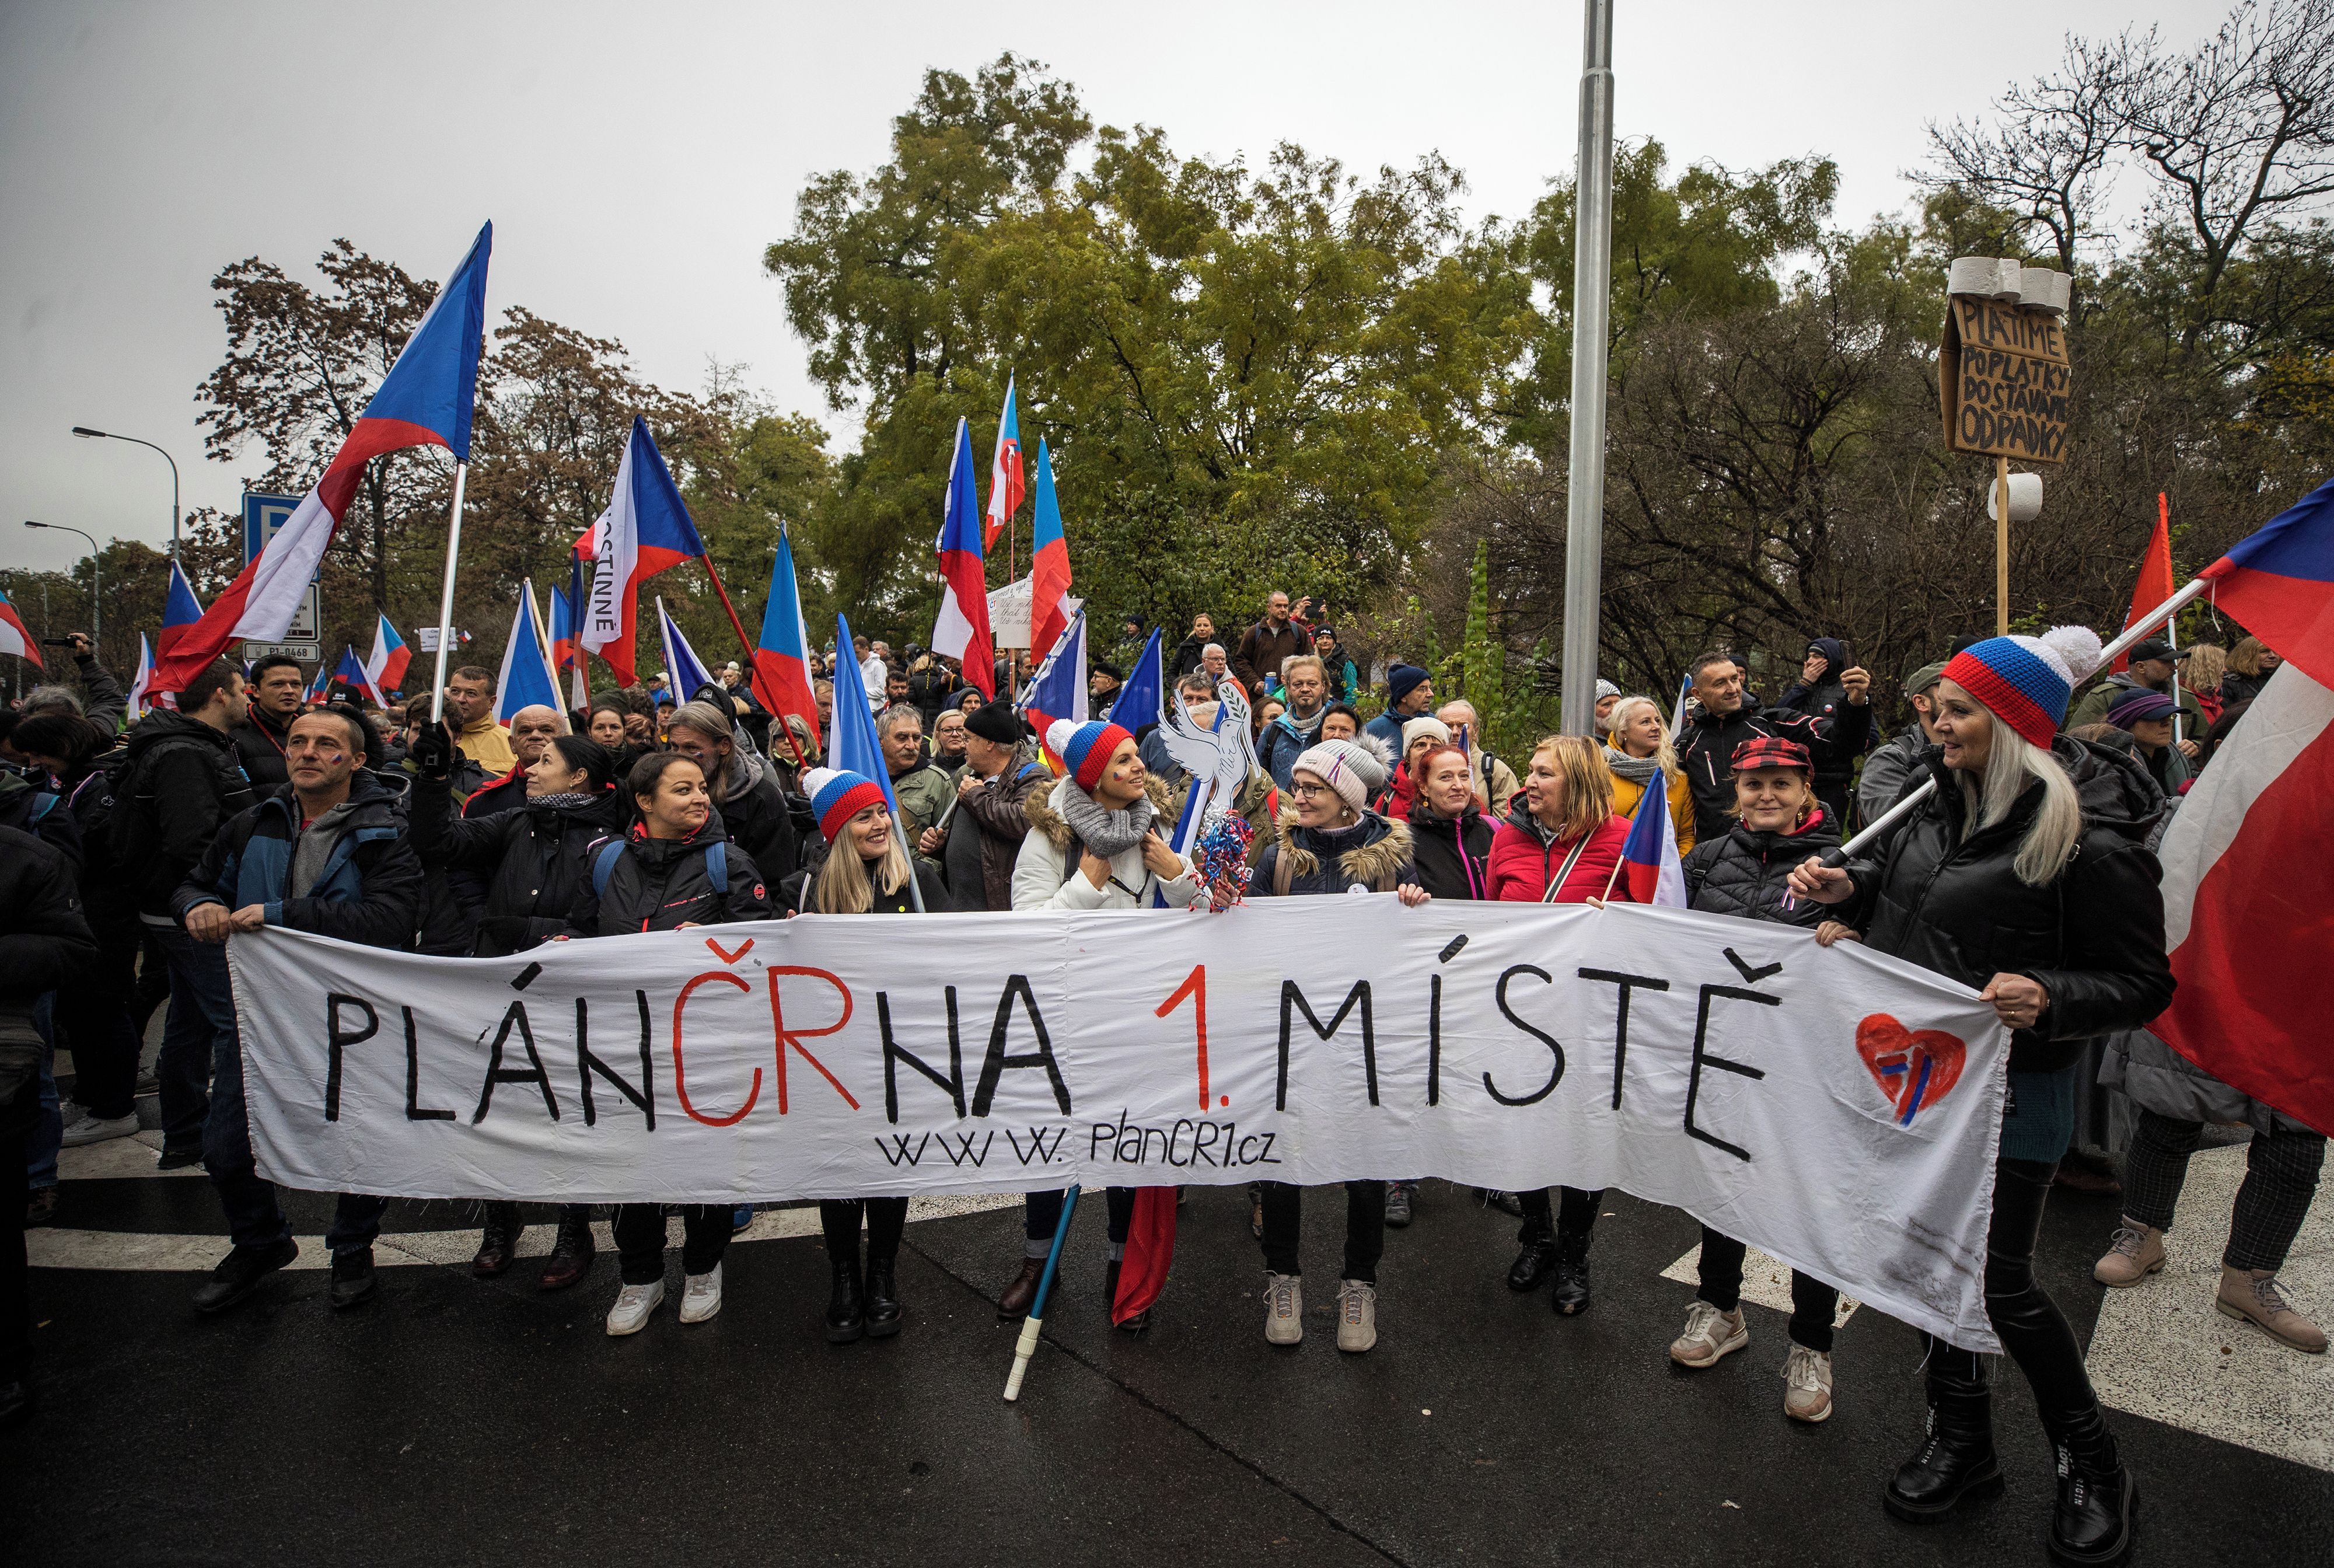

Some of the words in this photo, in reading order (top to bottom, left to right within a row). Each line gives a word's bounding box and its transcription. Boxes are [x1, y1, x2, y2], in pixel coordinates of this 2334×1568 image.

[1963, 346, 2070, 391] POPLATKY
[1961, 403, 2067, 460] ODPADKY
[269, 647, 308, 657] P1-0468
[1218, 736, 1237, 779] Mír
[1154, 963, 1230, 1114] 1.
[1275, 934, 1783, 1163] MÍSTĚ
